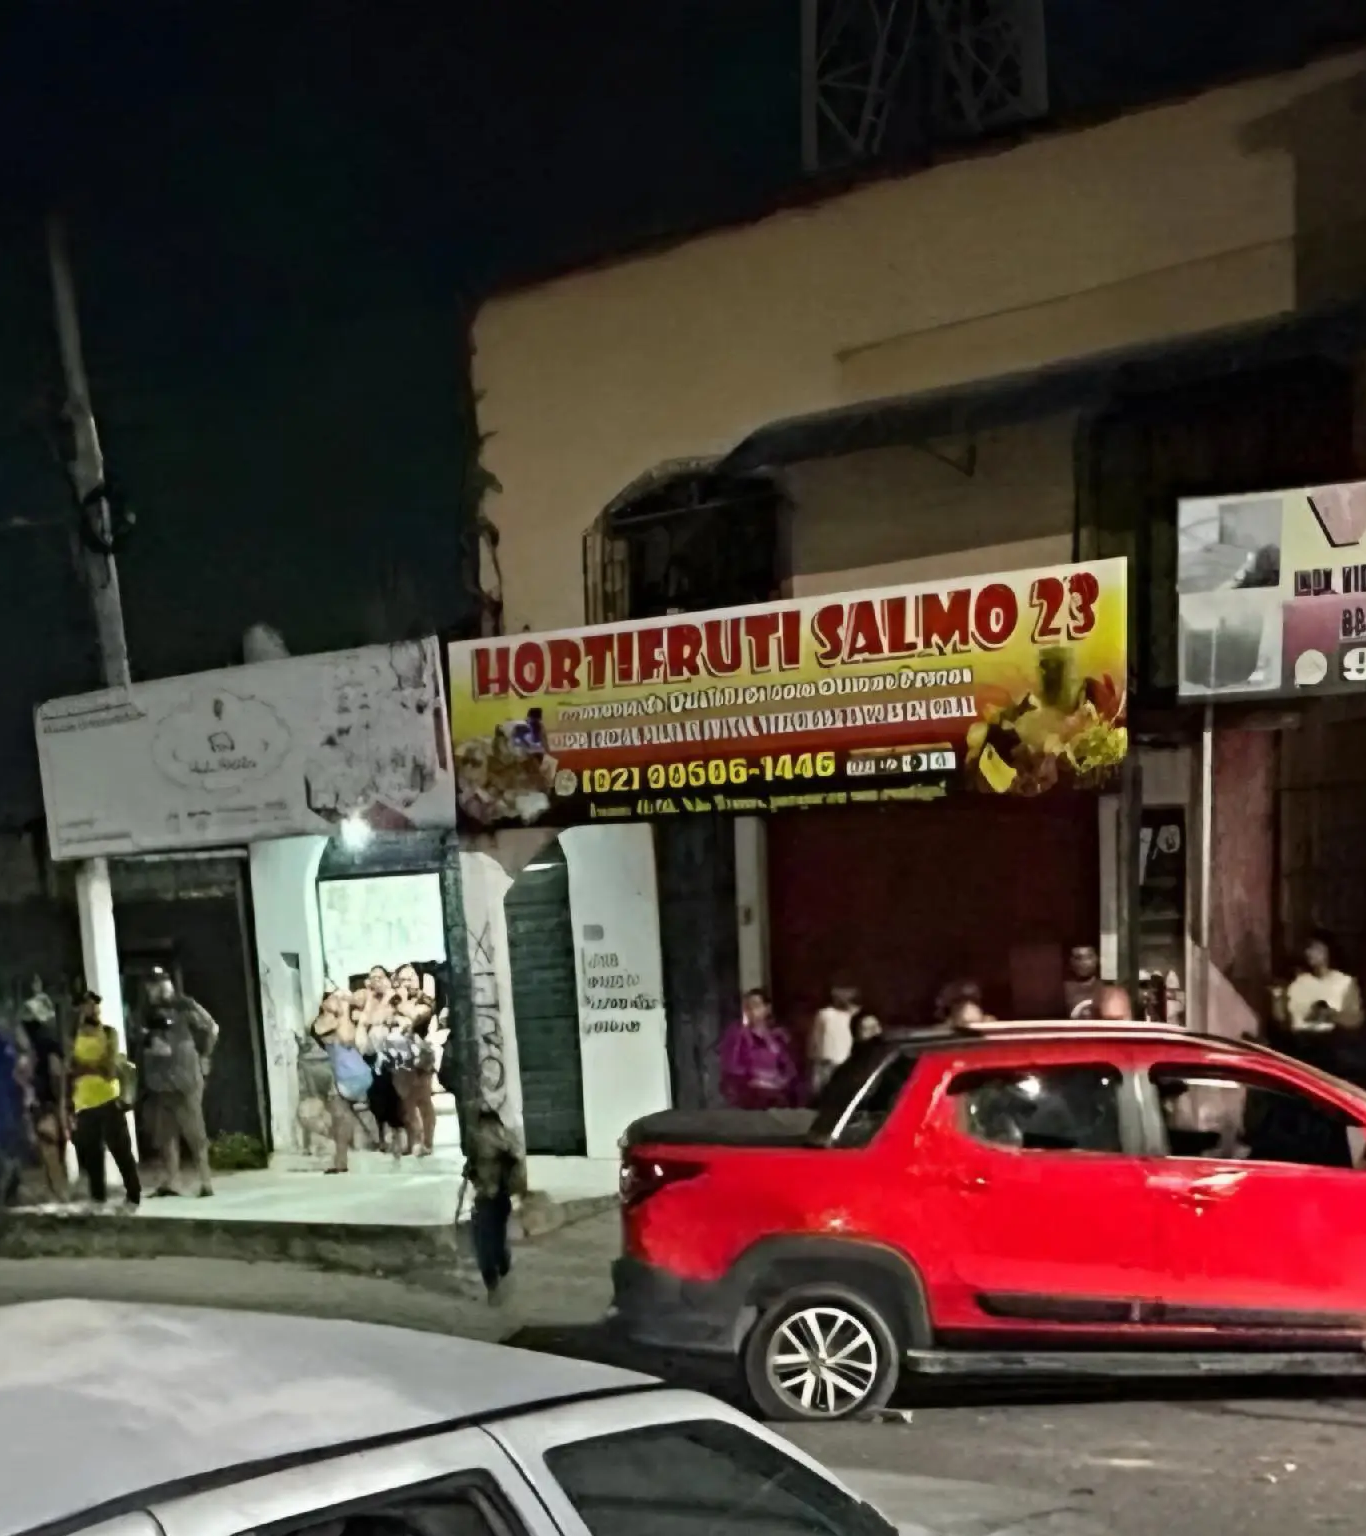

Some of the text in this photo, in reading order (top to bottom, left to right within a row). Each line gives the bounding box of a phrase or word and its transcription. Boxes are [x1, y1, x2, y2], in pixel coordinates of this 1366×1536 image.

[471, 610, 801, 699] HORTIFRUTI
[813, 582, 1019, 666] SALMO
[1029, 571, 1100, 645] 23
